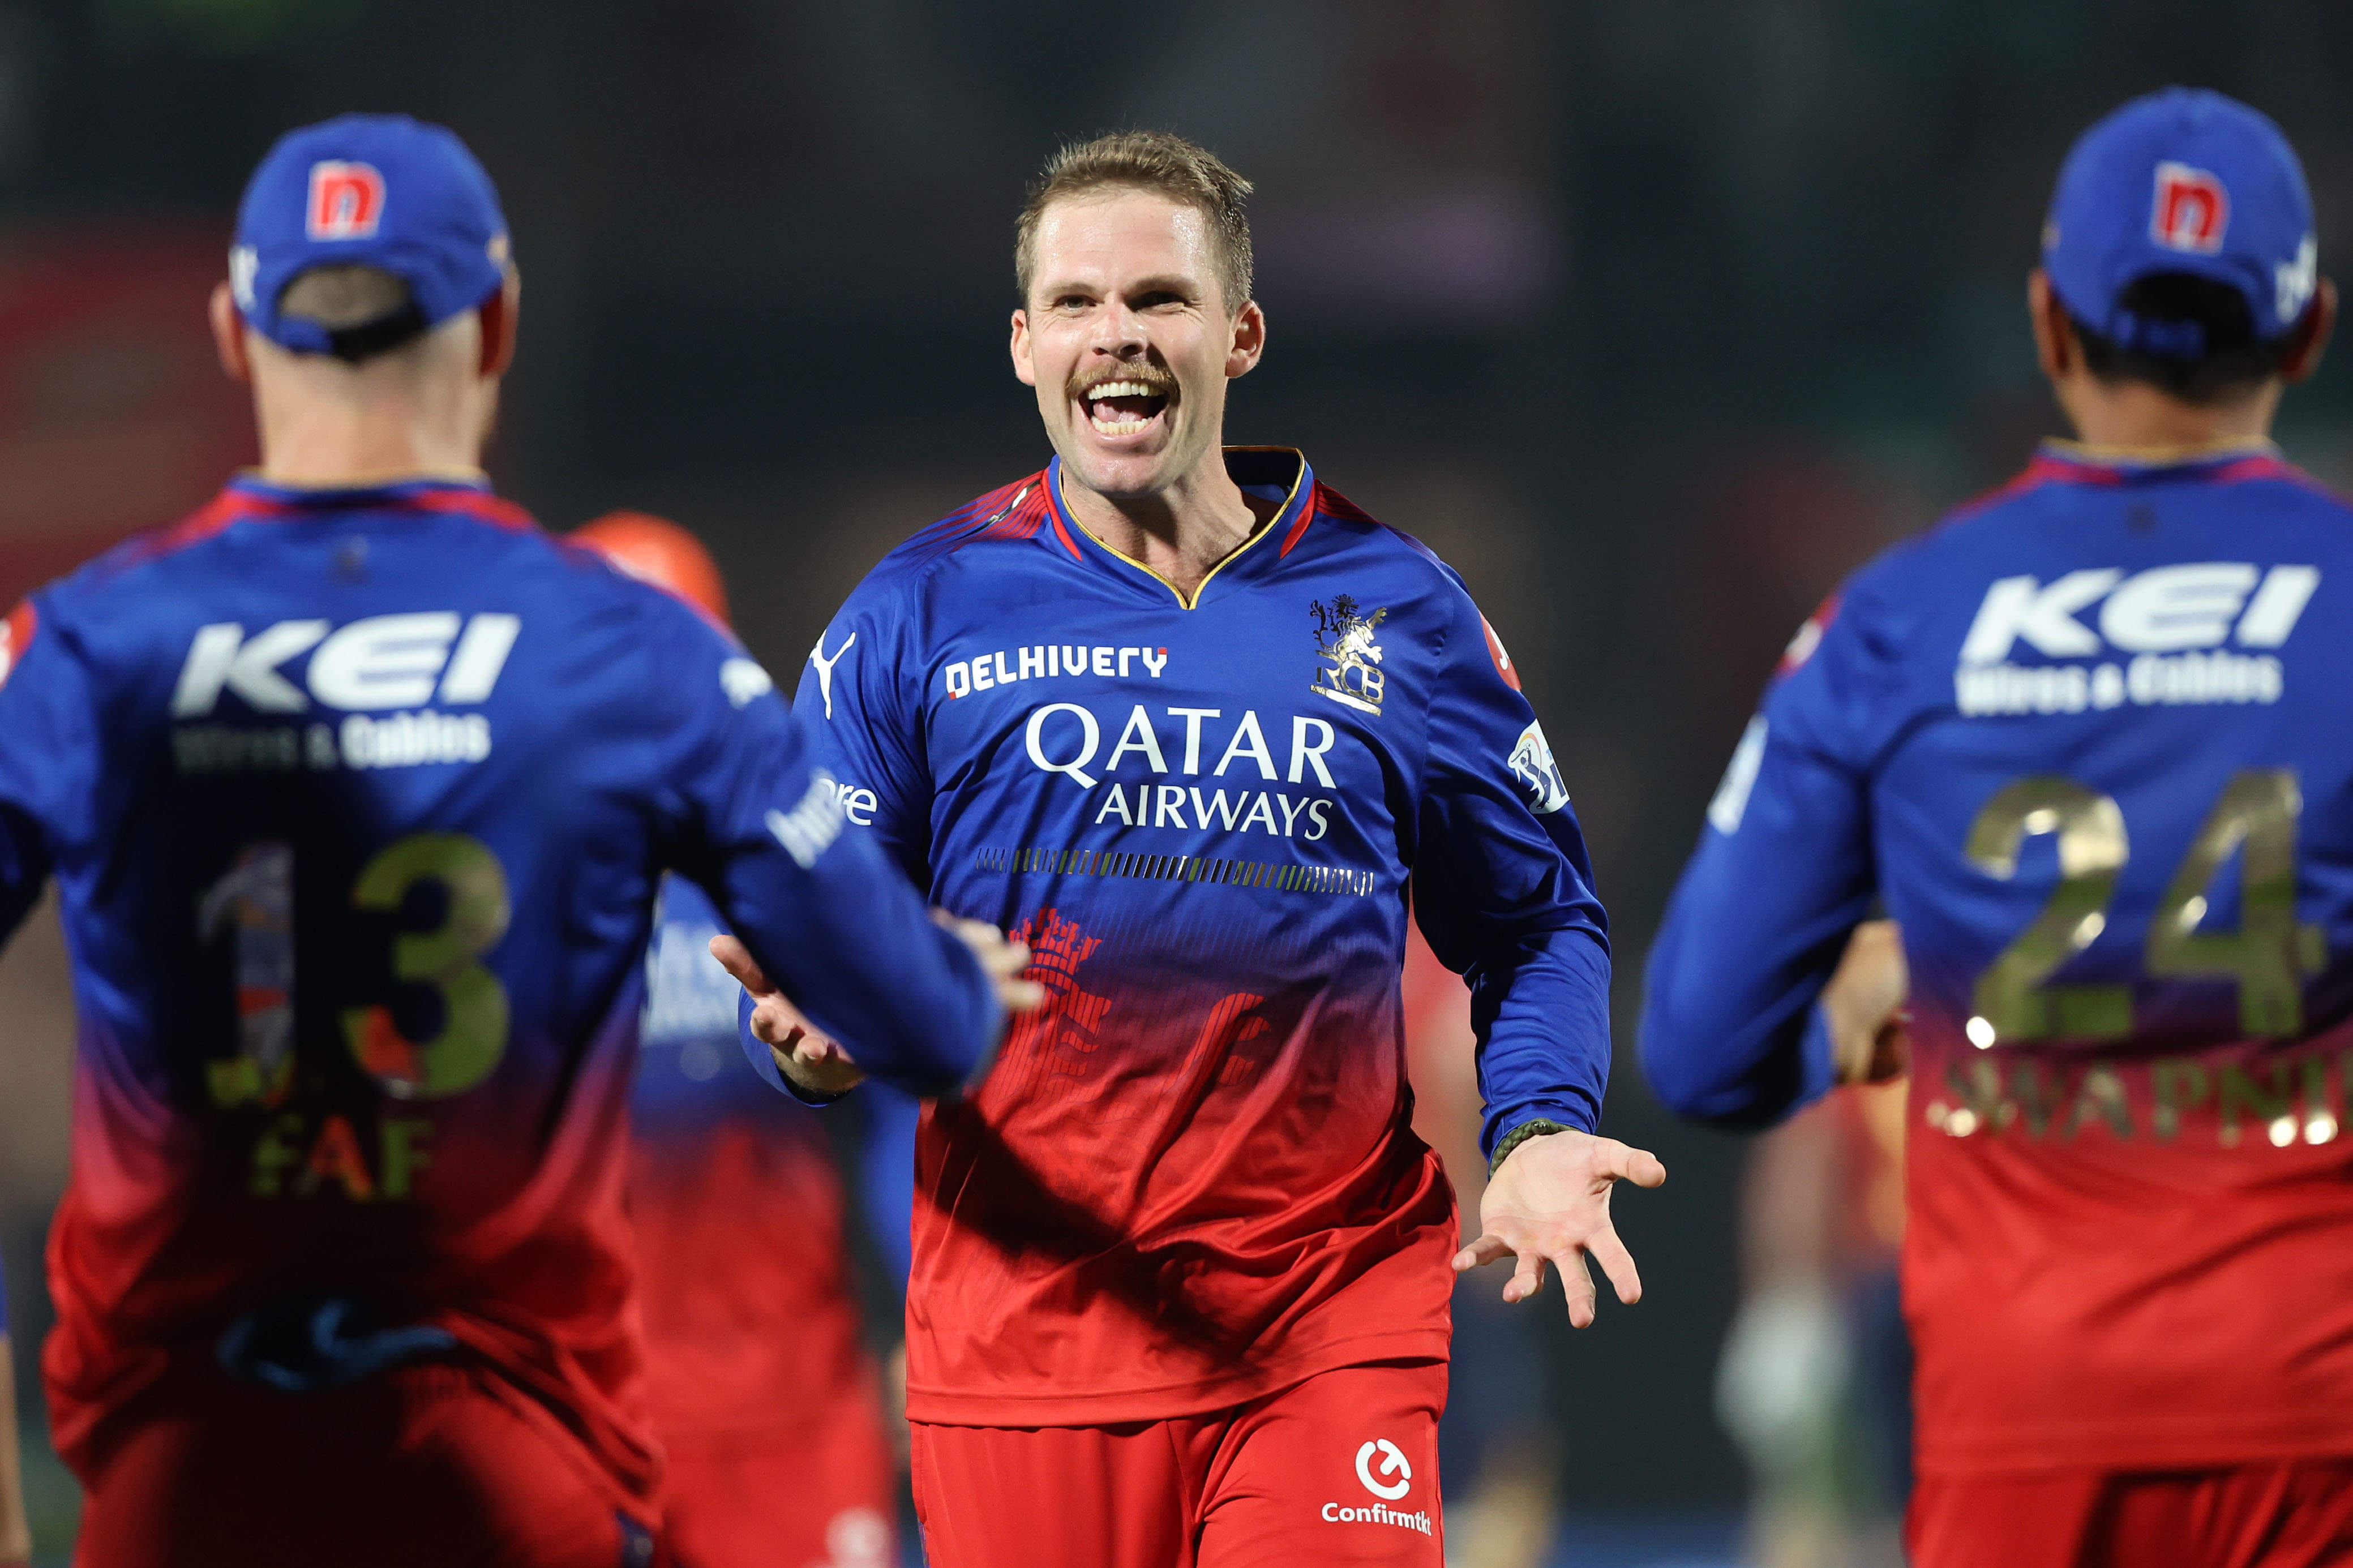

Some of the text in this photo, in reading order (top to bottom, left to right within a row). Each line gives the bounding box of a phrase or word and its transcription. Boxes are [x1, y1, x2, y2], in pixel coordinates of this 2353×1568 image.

[1958, 562, 2321, 665] KEI
[171, 612, 521, 718] KEI
[1025, 703, 1336, 789] QATAR
[1095, 783, 1332, 841] AIRWAYS
[1962, 768, 2328, 1050] 24
[196, 830, 512, 1110] 13
[249, 1114, 436, 1203] FAF
[1321, 1502, 1432, 1536] Confirmtkt
